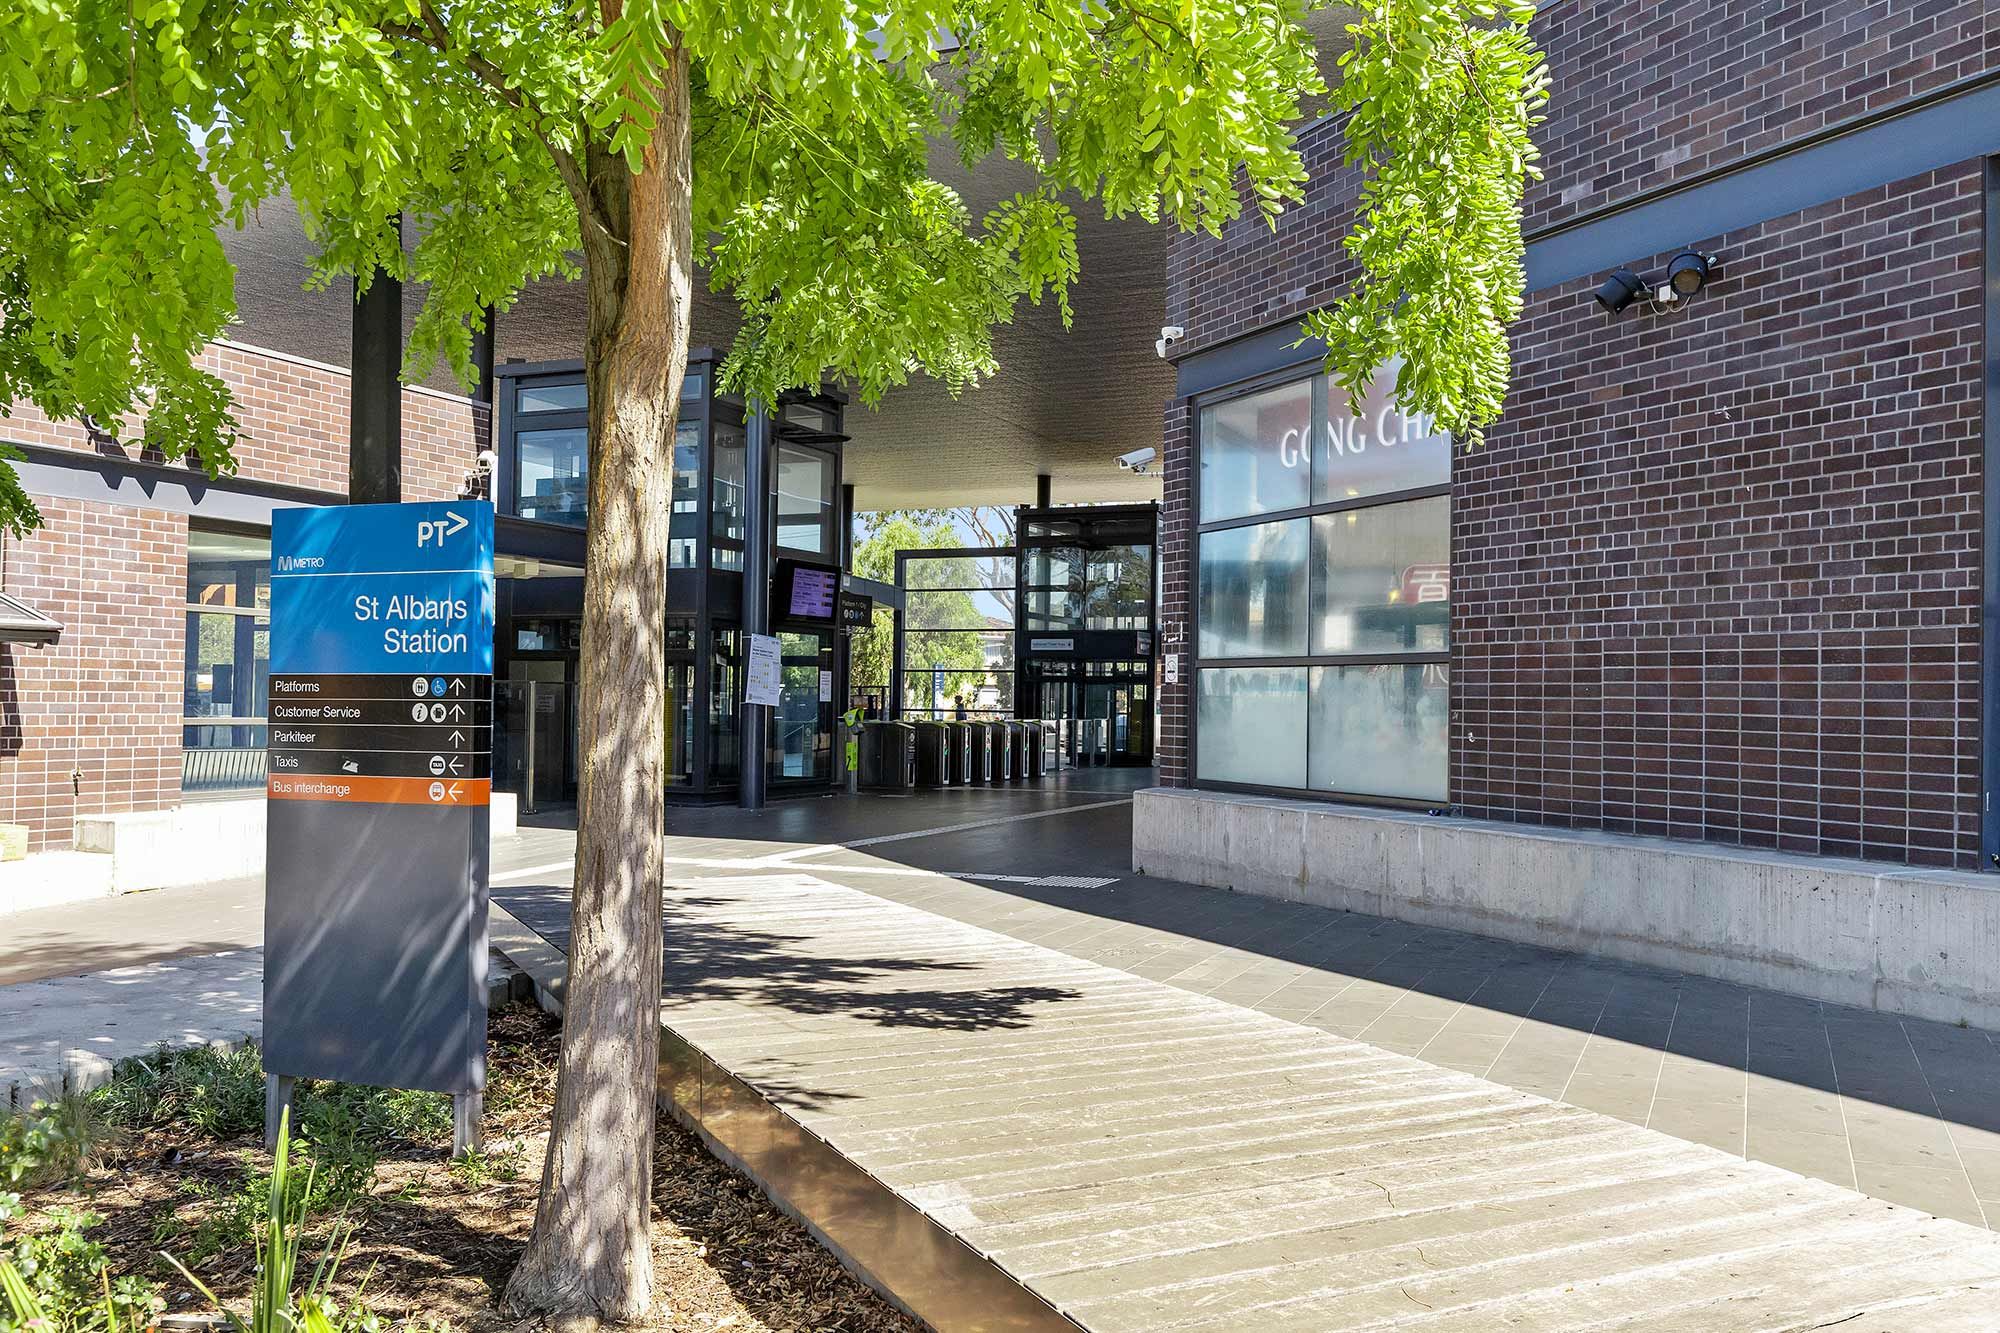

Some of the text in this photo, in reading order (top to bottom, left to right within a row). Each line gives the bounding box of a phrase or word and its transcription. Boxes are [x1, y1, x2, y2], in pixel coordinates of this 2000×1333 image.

[293, 557, 324, 569] METRO
[355, 595, 467, 621] St Albans
[384, 627, 467, 654] Station
[275, 680, 320, 693] Platforms
[274, 705, 361, 718] Customer Service
[274, 730, 316, 744] Parkiteer
[274, 756, 299, 768] Taxis
[273, 781, 350, 798] Bus interchange
